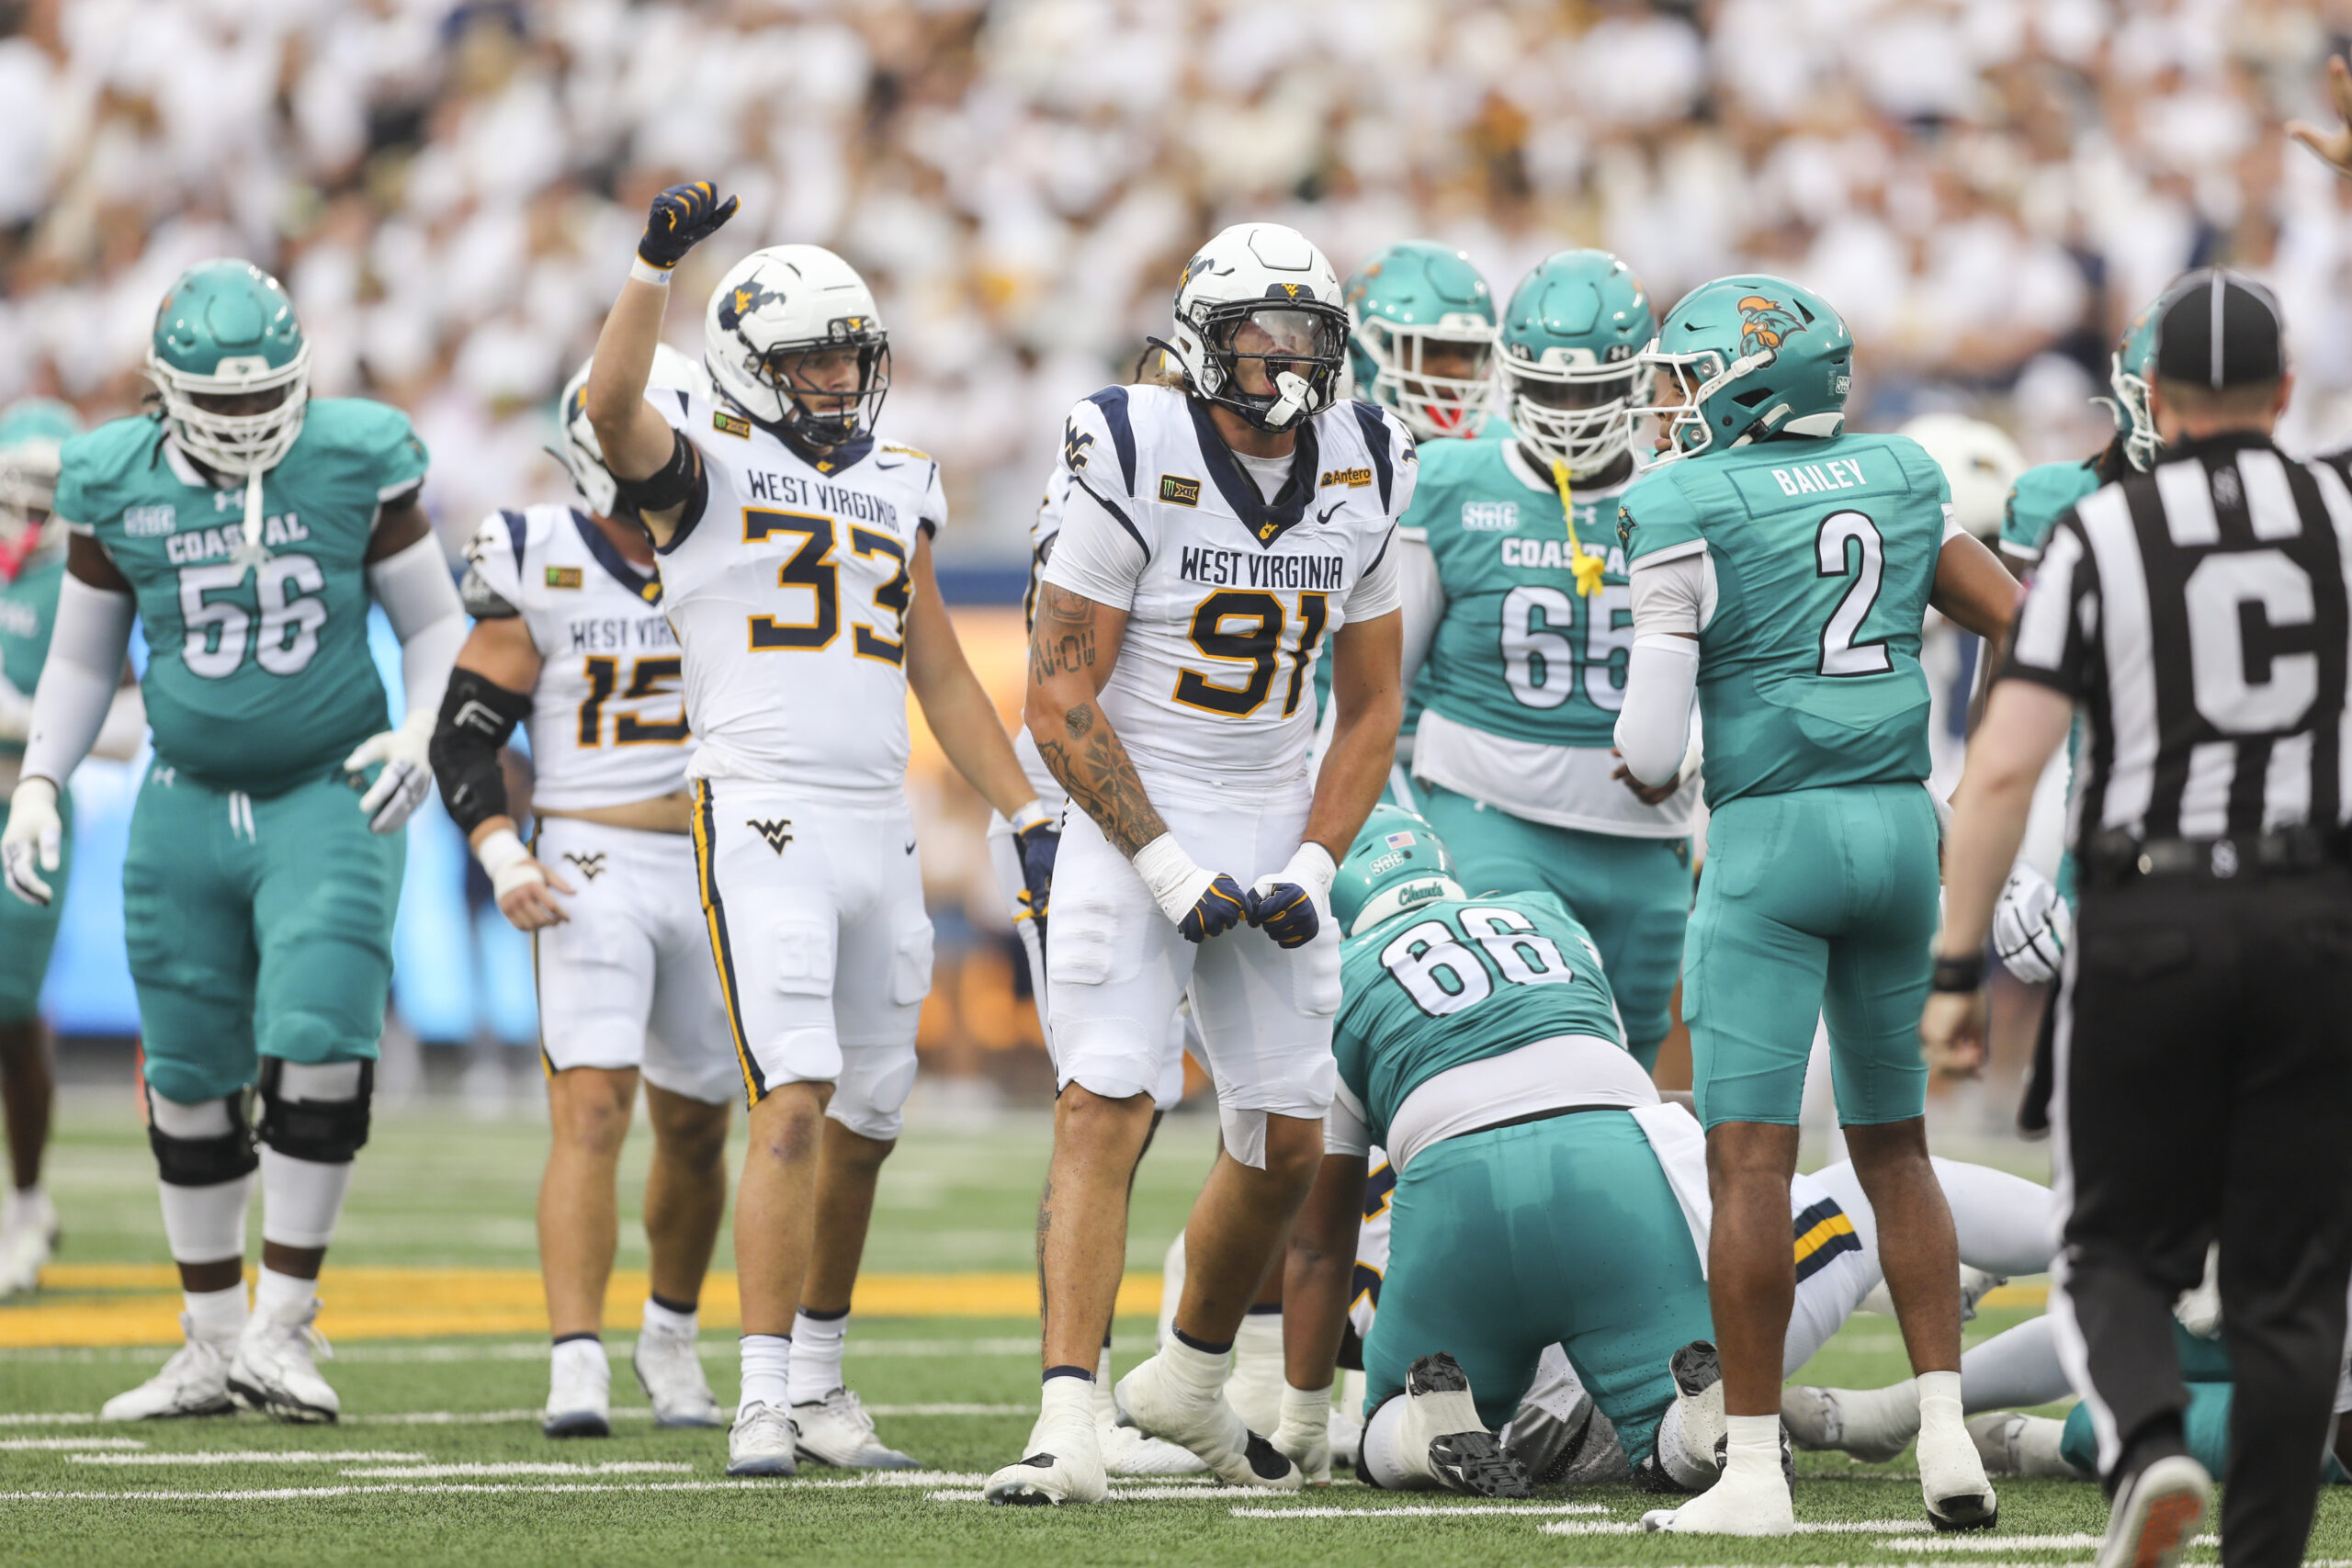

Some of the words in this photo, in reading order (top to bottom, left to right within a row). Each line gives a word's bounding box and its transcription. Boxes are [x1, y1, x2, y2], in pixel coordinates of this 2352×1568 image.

[747, 469, 814, 506] WEST
[814, 482, 900, 535] VIRGINIA
[1333, 467, 1371, 484] Antero
[1770, 458, 1867, 496] BAILEY
[165, 512, 310, 565] COASAL
[1180, 546, 1242, 585] WEST
[1248, 554, 1343, 589] VIRGINIA
[178, 553, 327, 678] 56
[571, 617, 628, 650] WEST
[741, 507, 915, 671] 33
[1815, 509, 1894, 677] 2
[1171, 588, 1329, 720] 91
[1500, 585, 1634, 711] 65
[2184, 548, 2319, 733] C
[577, 655, 693, 748] 15
[1370, 850, 1404, 876] SBC
[1379, 907, 1575, 1019] 66
